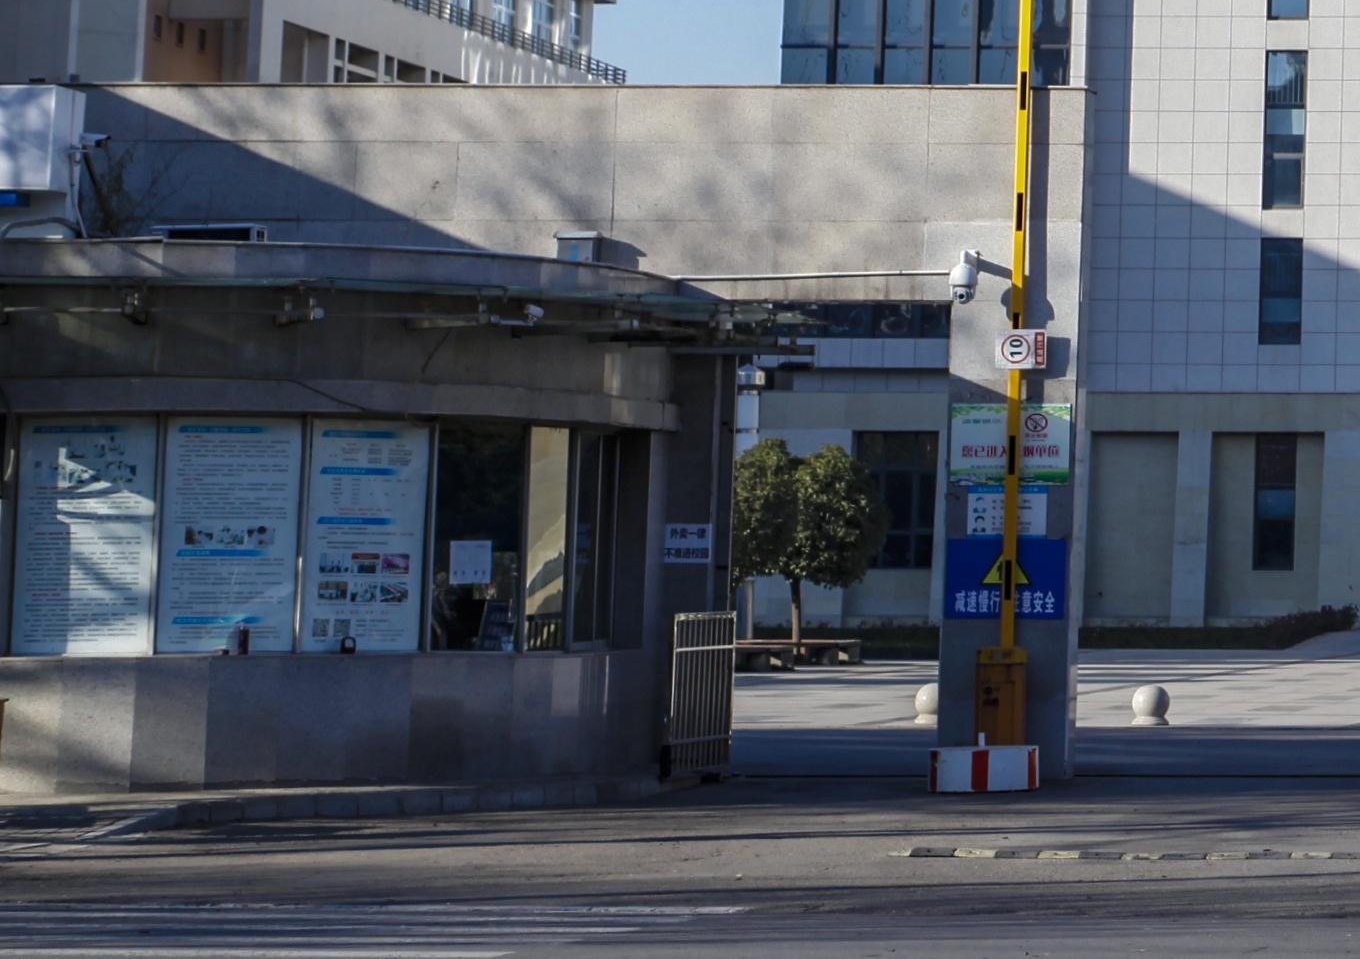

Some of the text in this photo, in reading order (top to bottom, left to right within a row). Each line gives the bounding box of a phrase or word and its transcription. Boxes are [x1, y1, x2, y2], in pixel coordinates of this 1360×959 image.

[1009, 338, 1024, 358] 10
[954, 590, 1000, 613] 减速慢行
